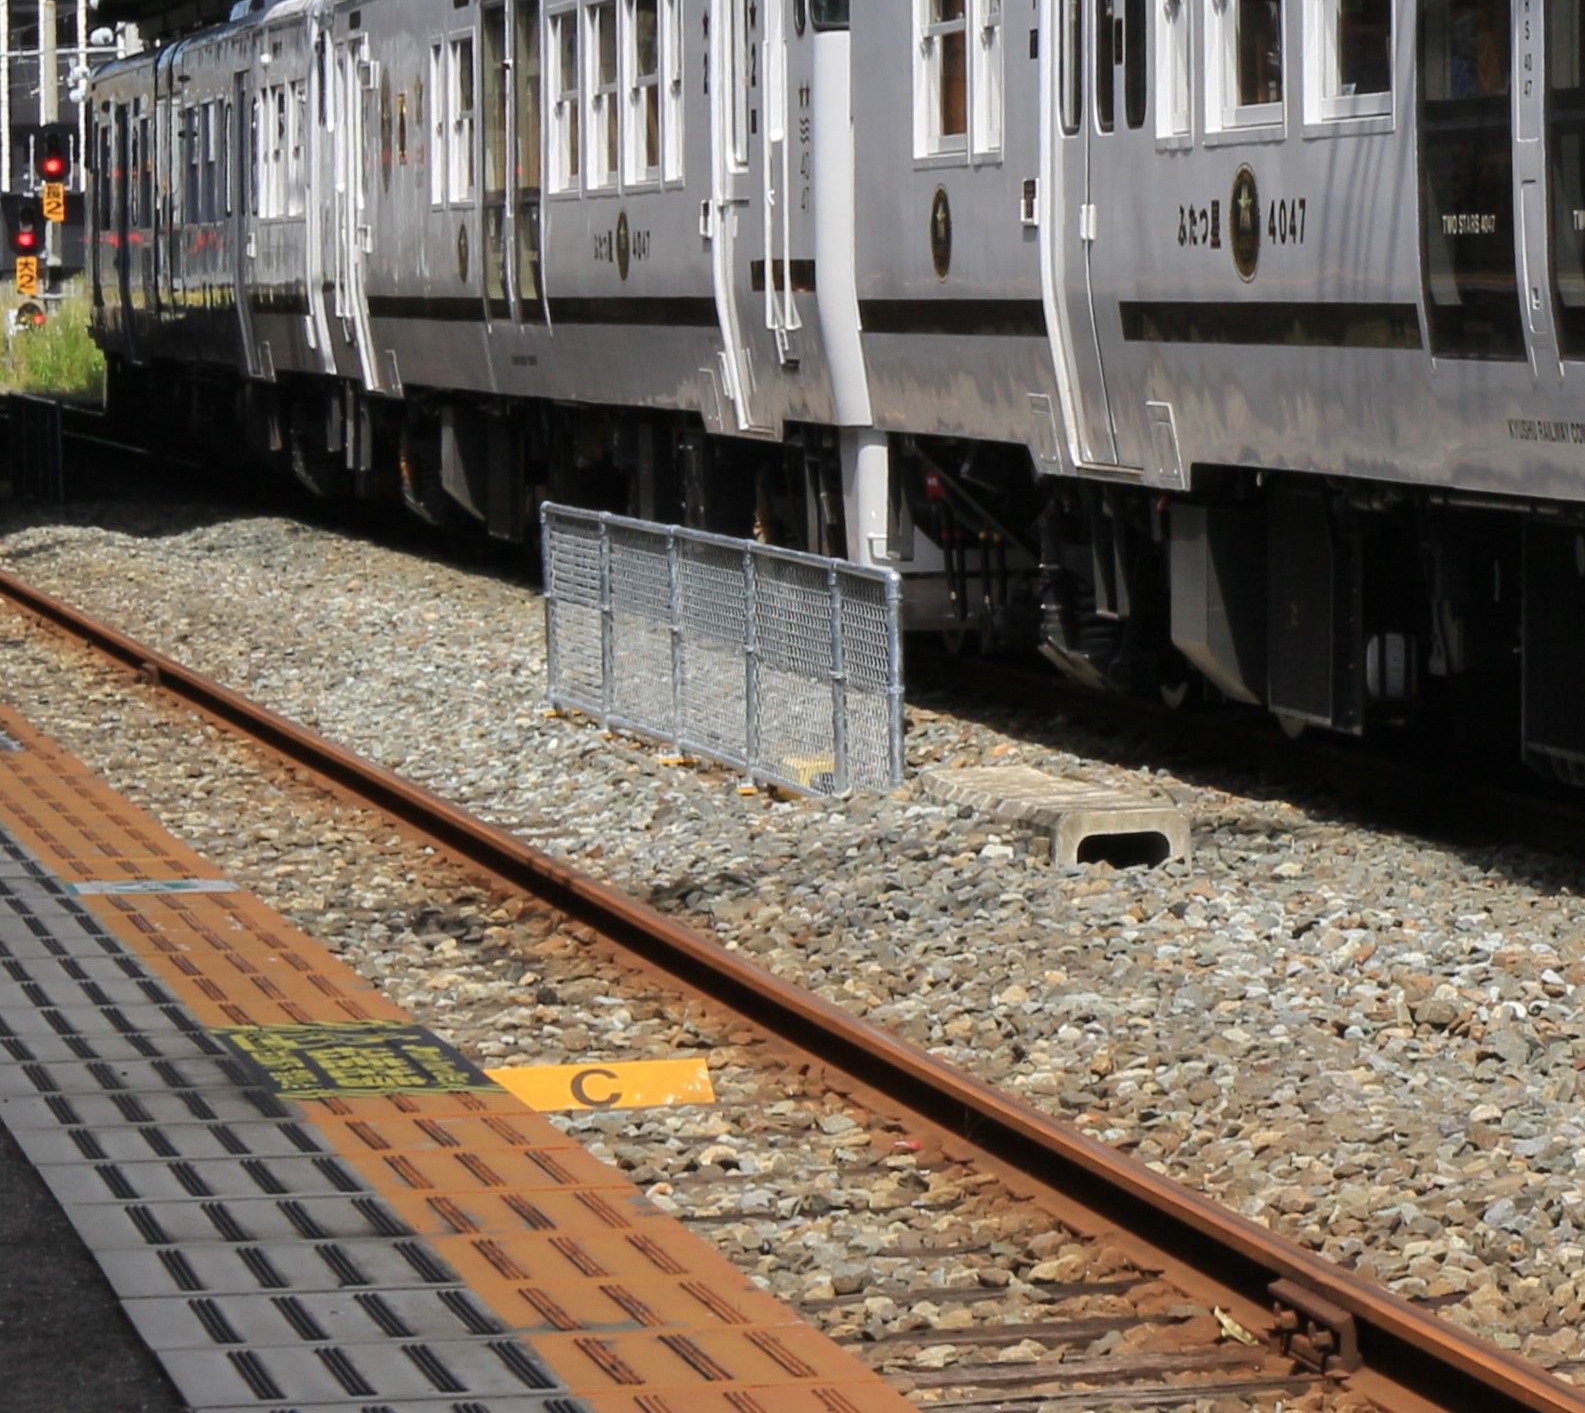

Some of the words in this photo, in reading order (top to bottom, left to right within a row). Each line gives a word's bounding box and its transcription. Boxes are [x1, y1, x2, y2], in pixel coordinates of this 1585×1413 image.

[1268, 198, 1306, 245] 4047
[1442, 215, 1457, 234] TWO
[1458, 214, 1480, 234] STARS
[1481, 215, 1496, 234] 4047
[569, 1068, 623, 1107] C
